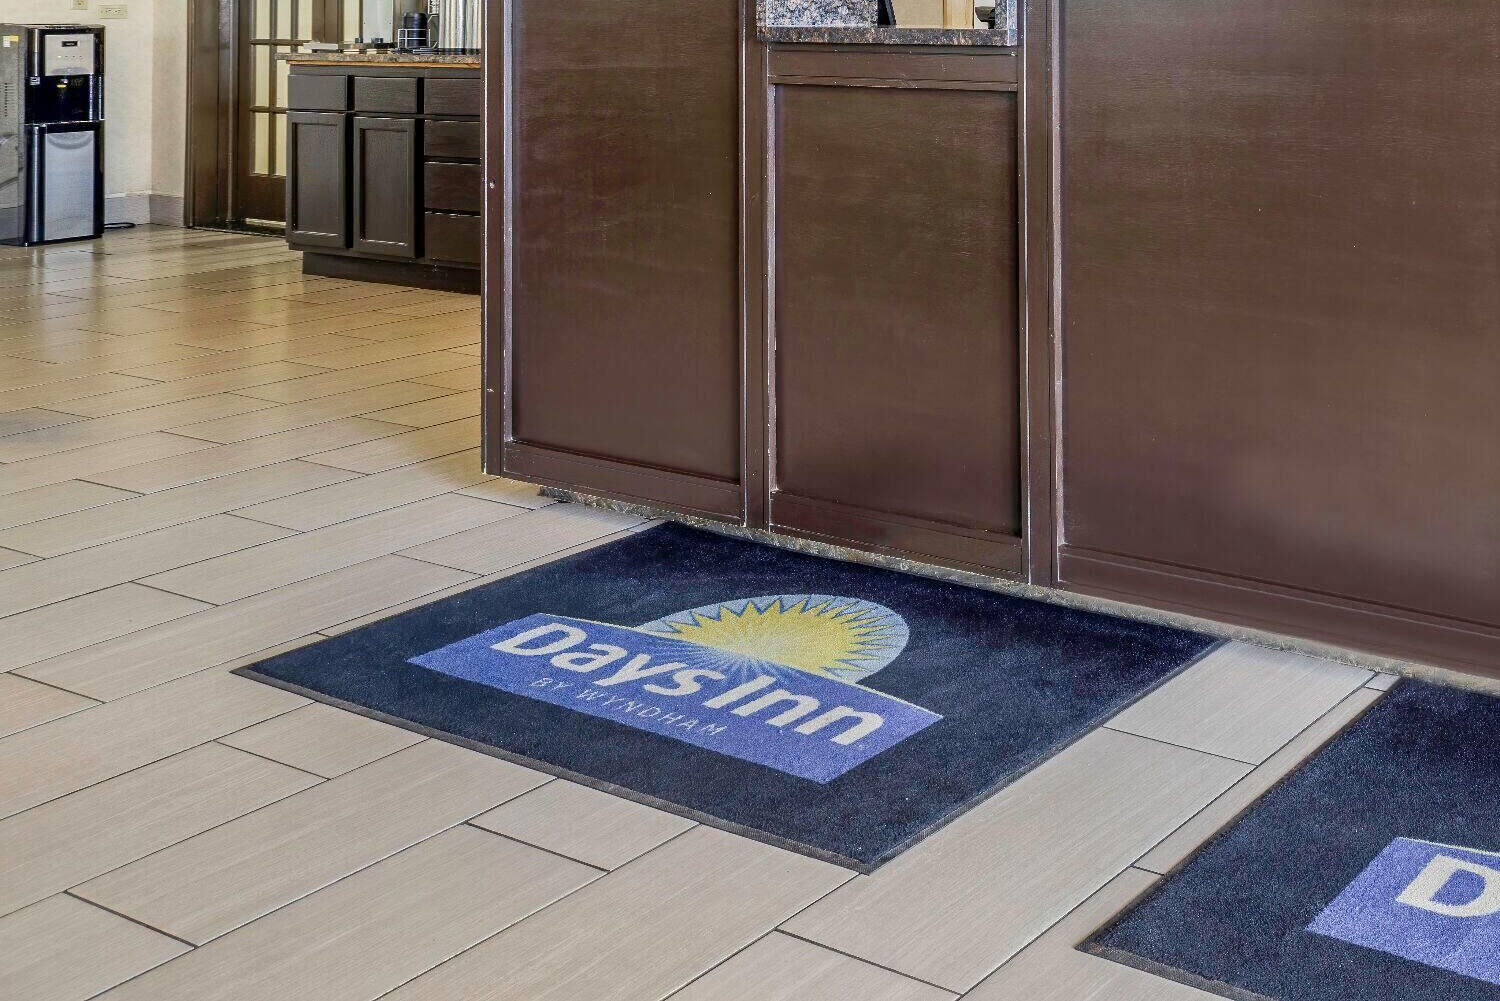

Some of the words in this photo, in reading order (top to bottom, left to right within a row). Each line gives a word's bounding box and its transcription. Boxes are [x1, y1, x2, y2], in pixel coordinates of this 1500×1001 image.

[491, 622, 725, 697] Days
[703, 674, 885, 745] Inn
[529, 676, 568, 691] BY
[576, 688, 728, 737] WYNDHAM
